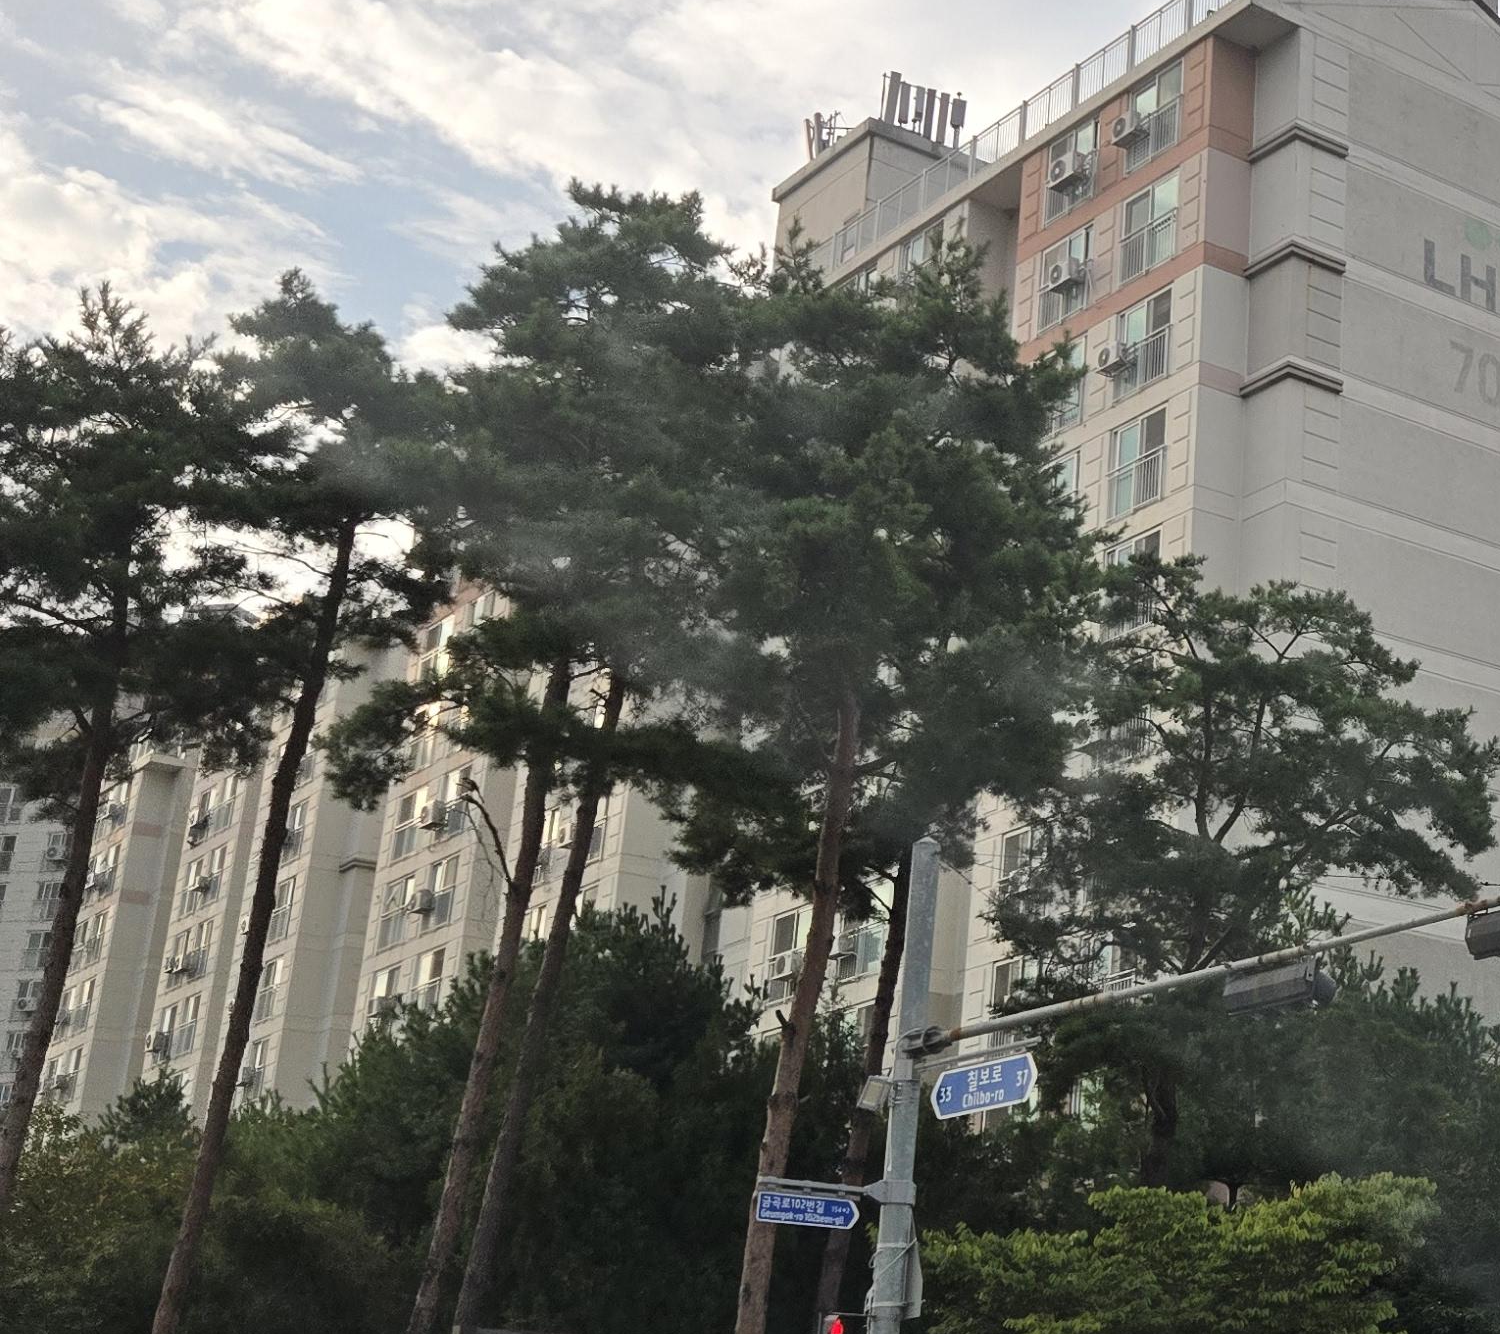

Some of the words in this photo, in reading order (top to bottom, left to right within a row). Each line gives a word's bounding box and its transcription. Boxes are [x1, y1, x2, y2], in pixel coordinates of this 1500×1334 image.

[1423, 237, 1497, 313] LH
[967, 1064, 1003, 1093] 칠보로
[1015, 1068, 1030, 1087] 37
[938, 1085, 953, 1104] 33
[961, 1088, 1005, 1109] Chilbo-ro
